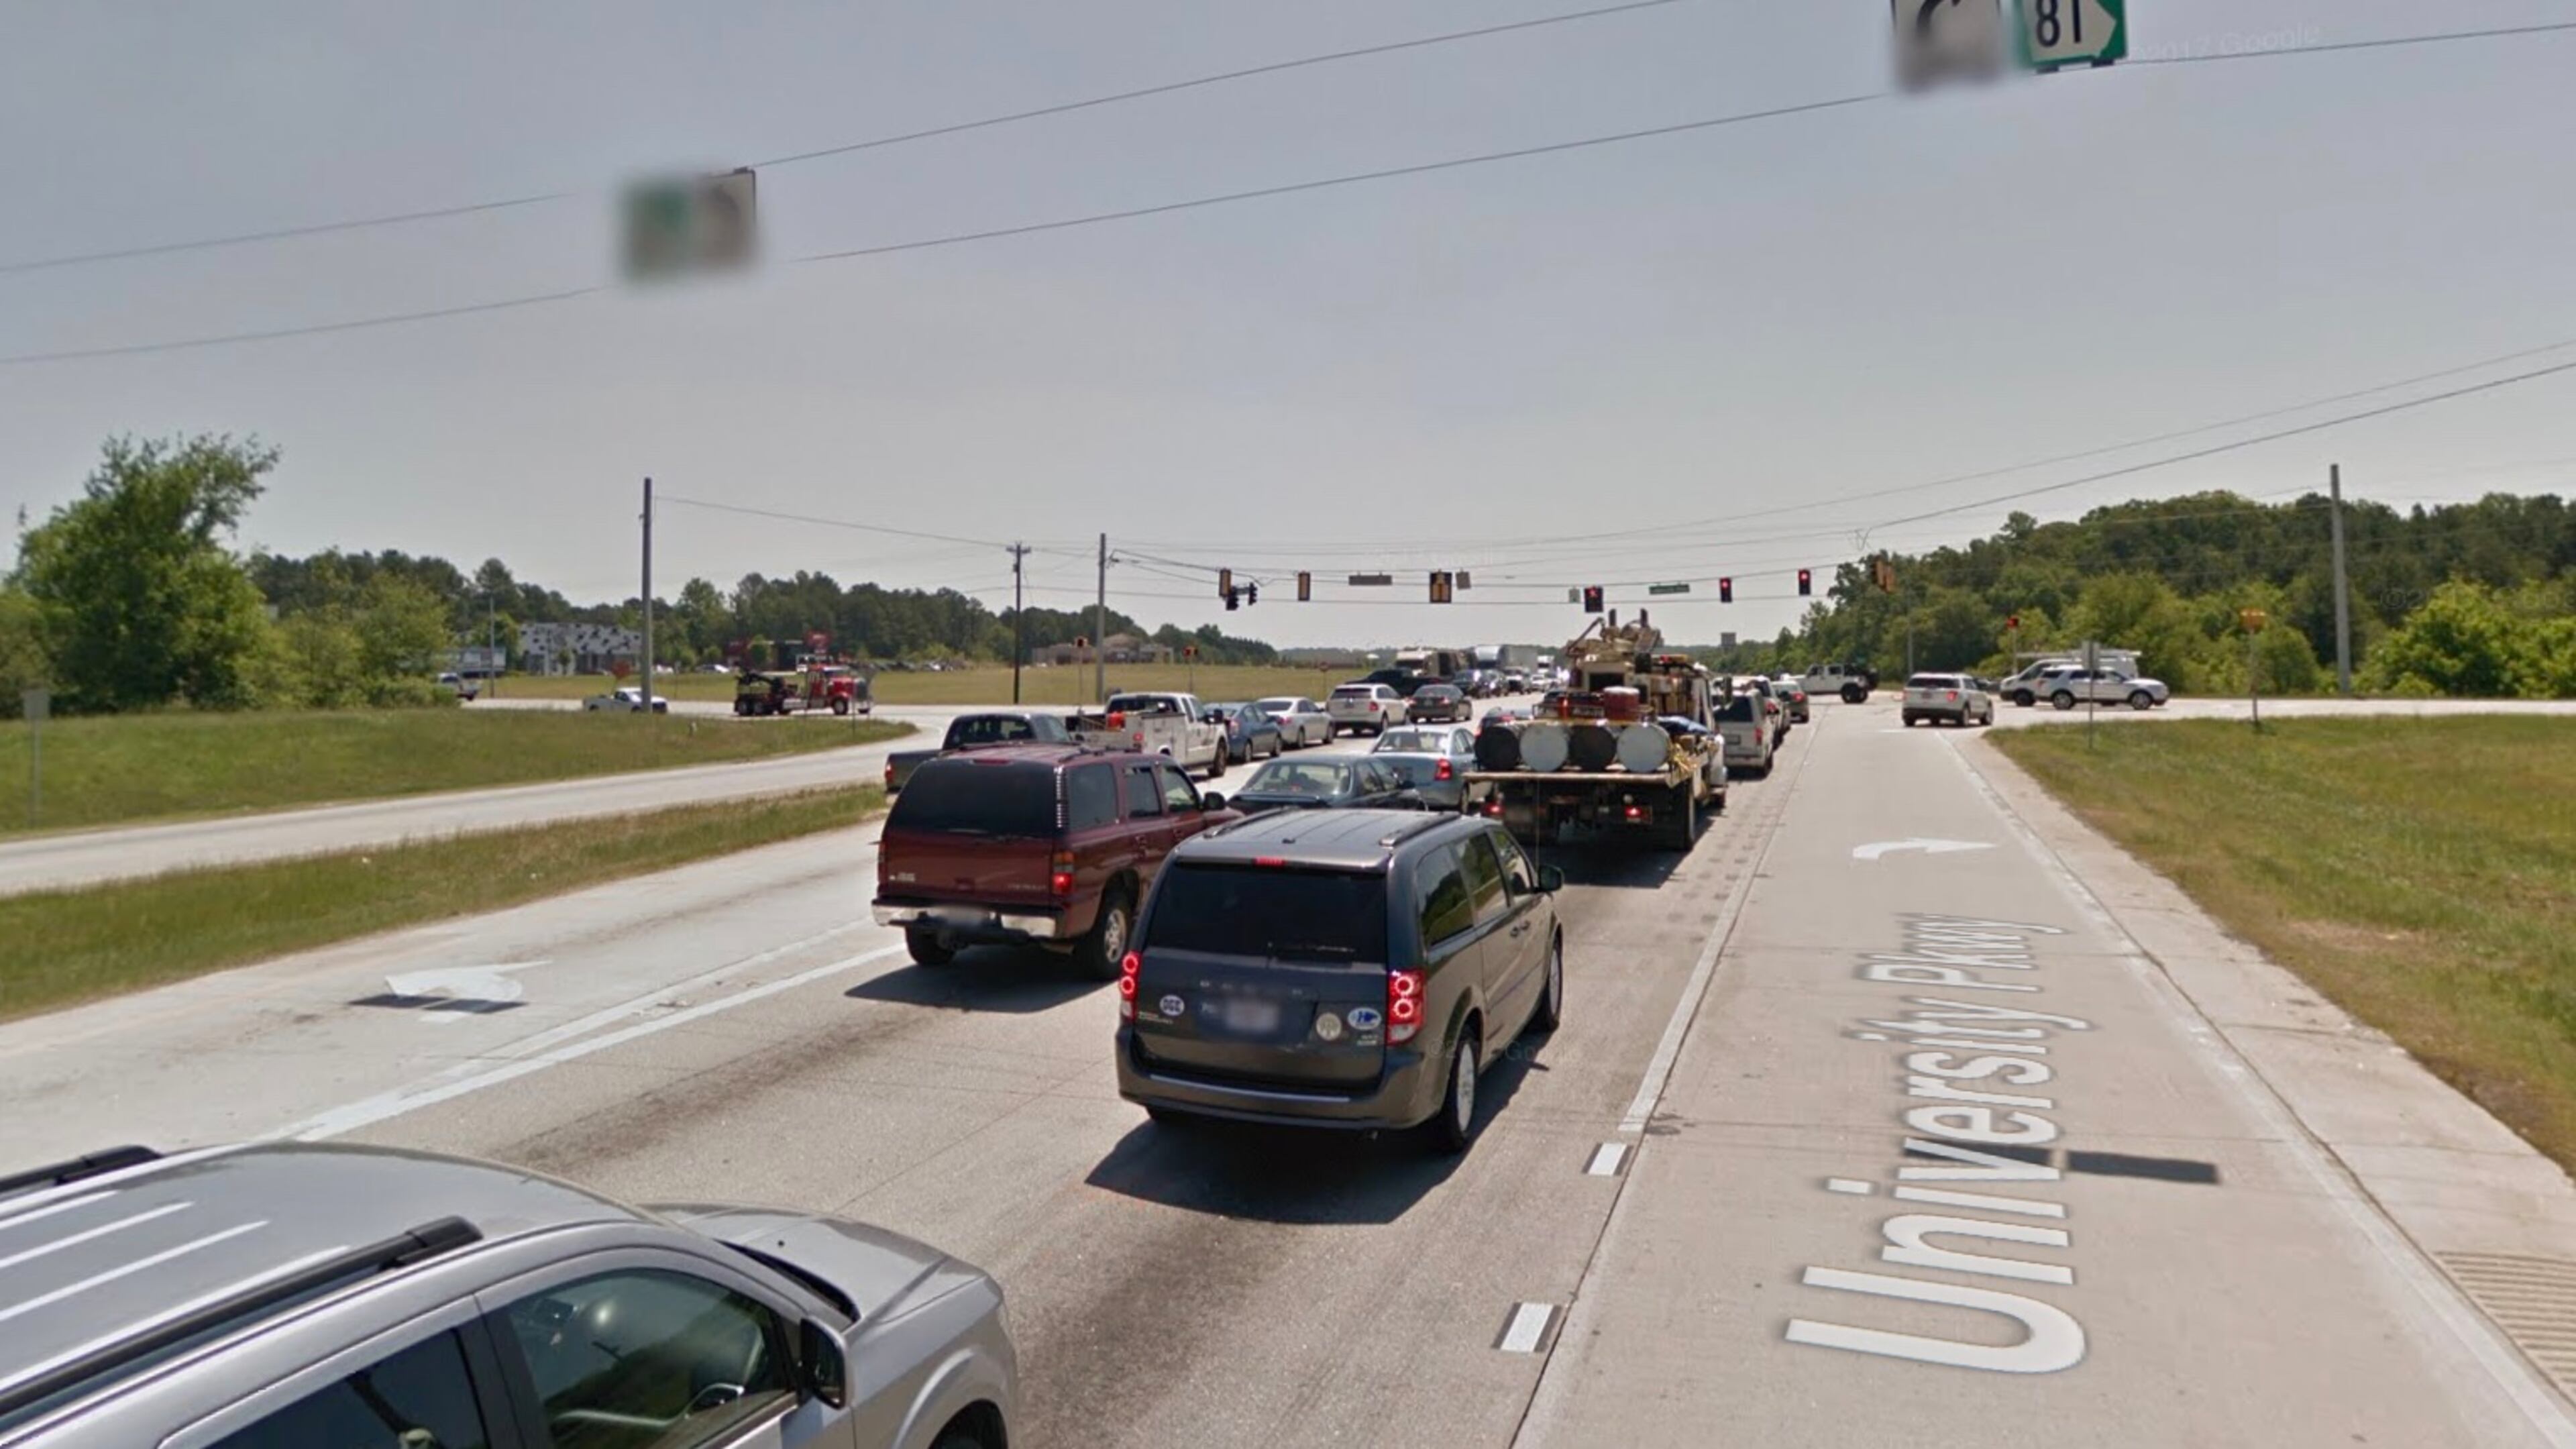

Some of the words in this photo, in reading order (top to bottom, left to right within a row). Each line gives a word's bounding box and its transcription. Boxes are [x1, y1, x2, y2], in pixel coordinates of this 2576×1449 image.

[2035, 0, 2082, 48] 81
[1858, 913, 2068, 993] Pkwy
[1784, 996, 2094, 1375] University
